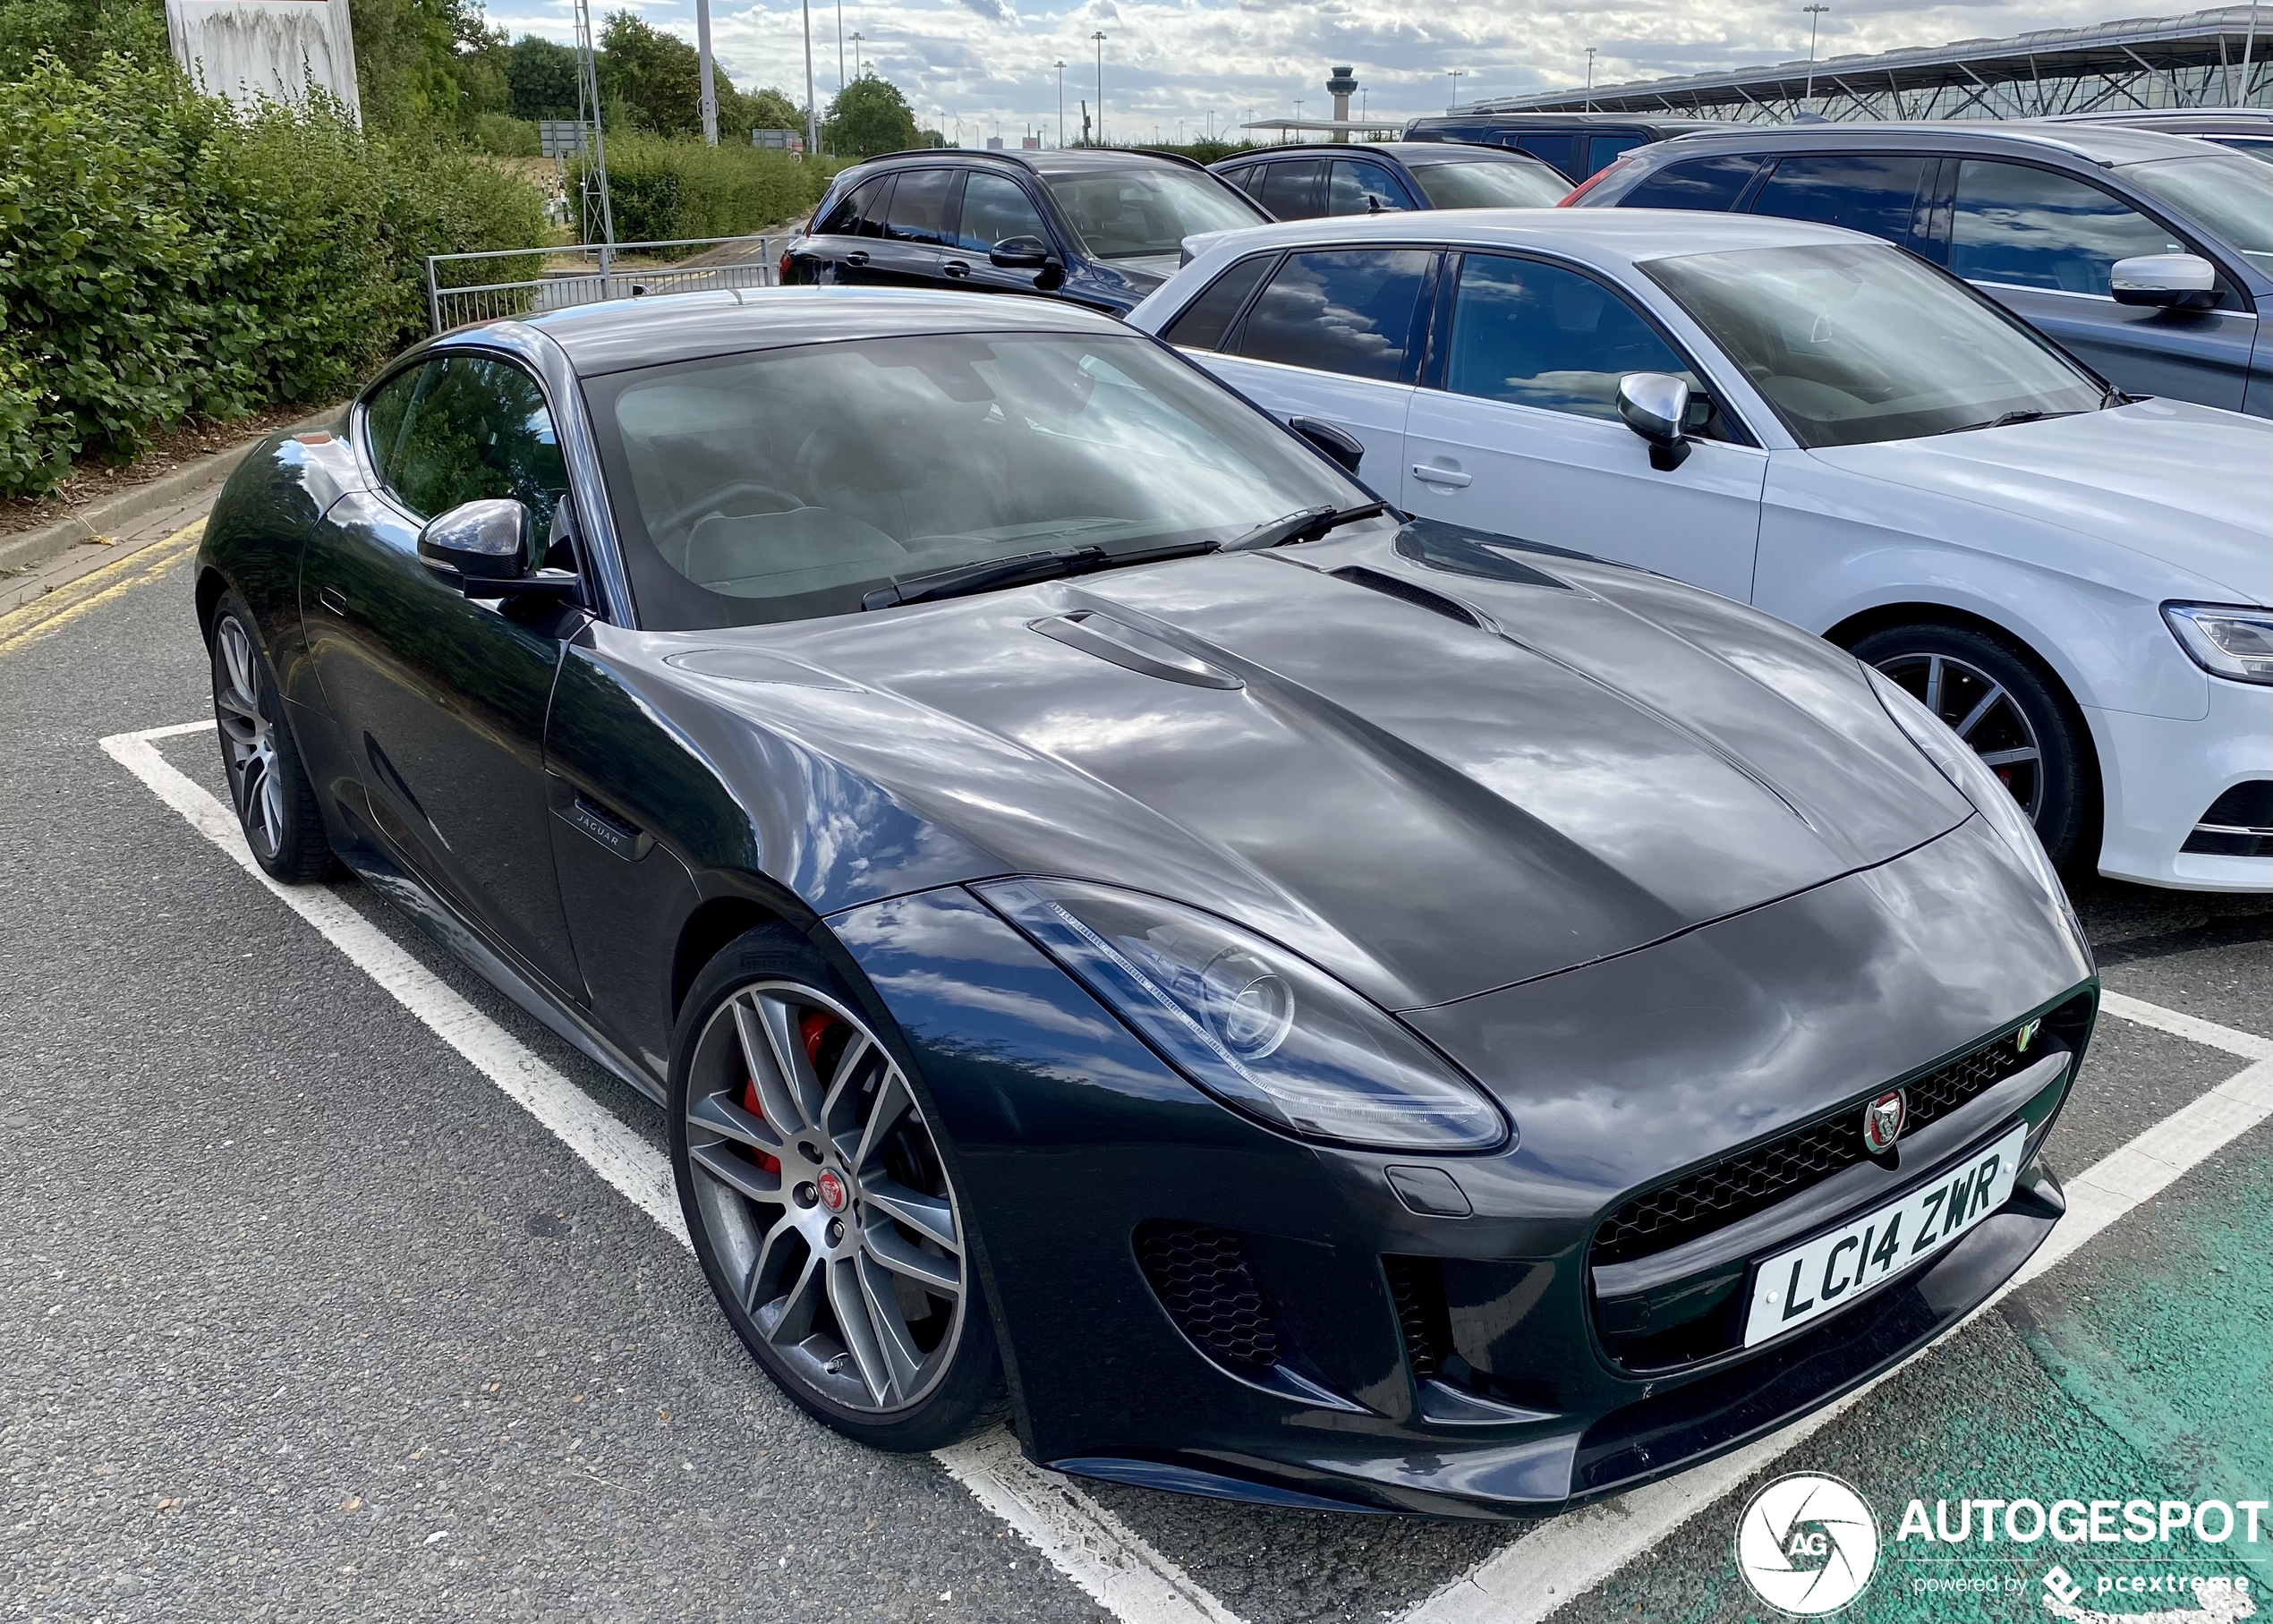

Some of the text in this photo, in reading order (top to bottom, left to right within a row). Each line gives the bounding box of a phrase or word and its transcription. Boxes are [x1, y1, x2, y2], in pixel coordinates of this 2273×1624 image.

[576, 815, 618, 846] JAGUAR
[1782, 1153, 2000, 1322] LC14 ZWR
